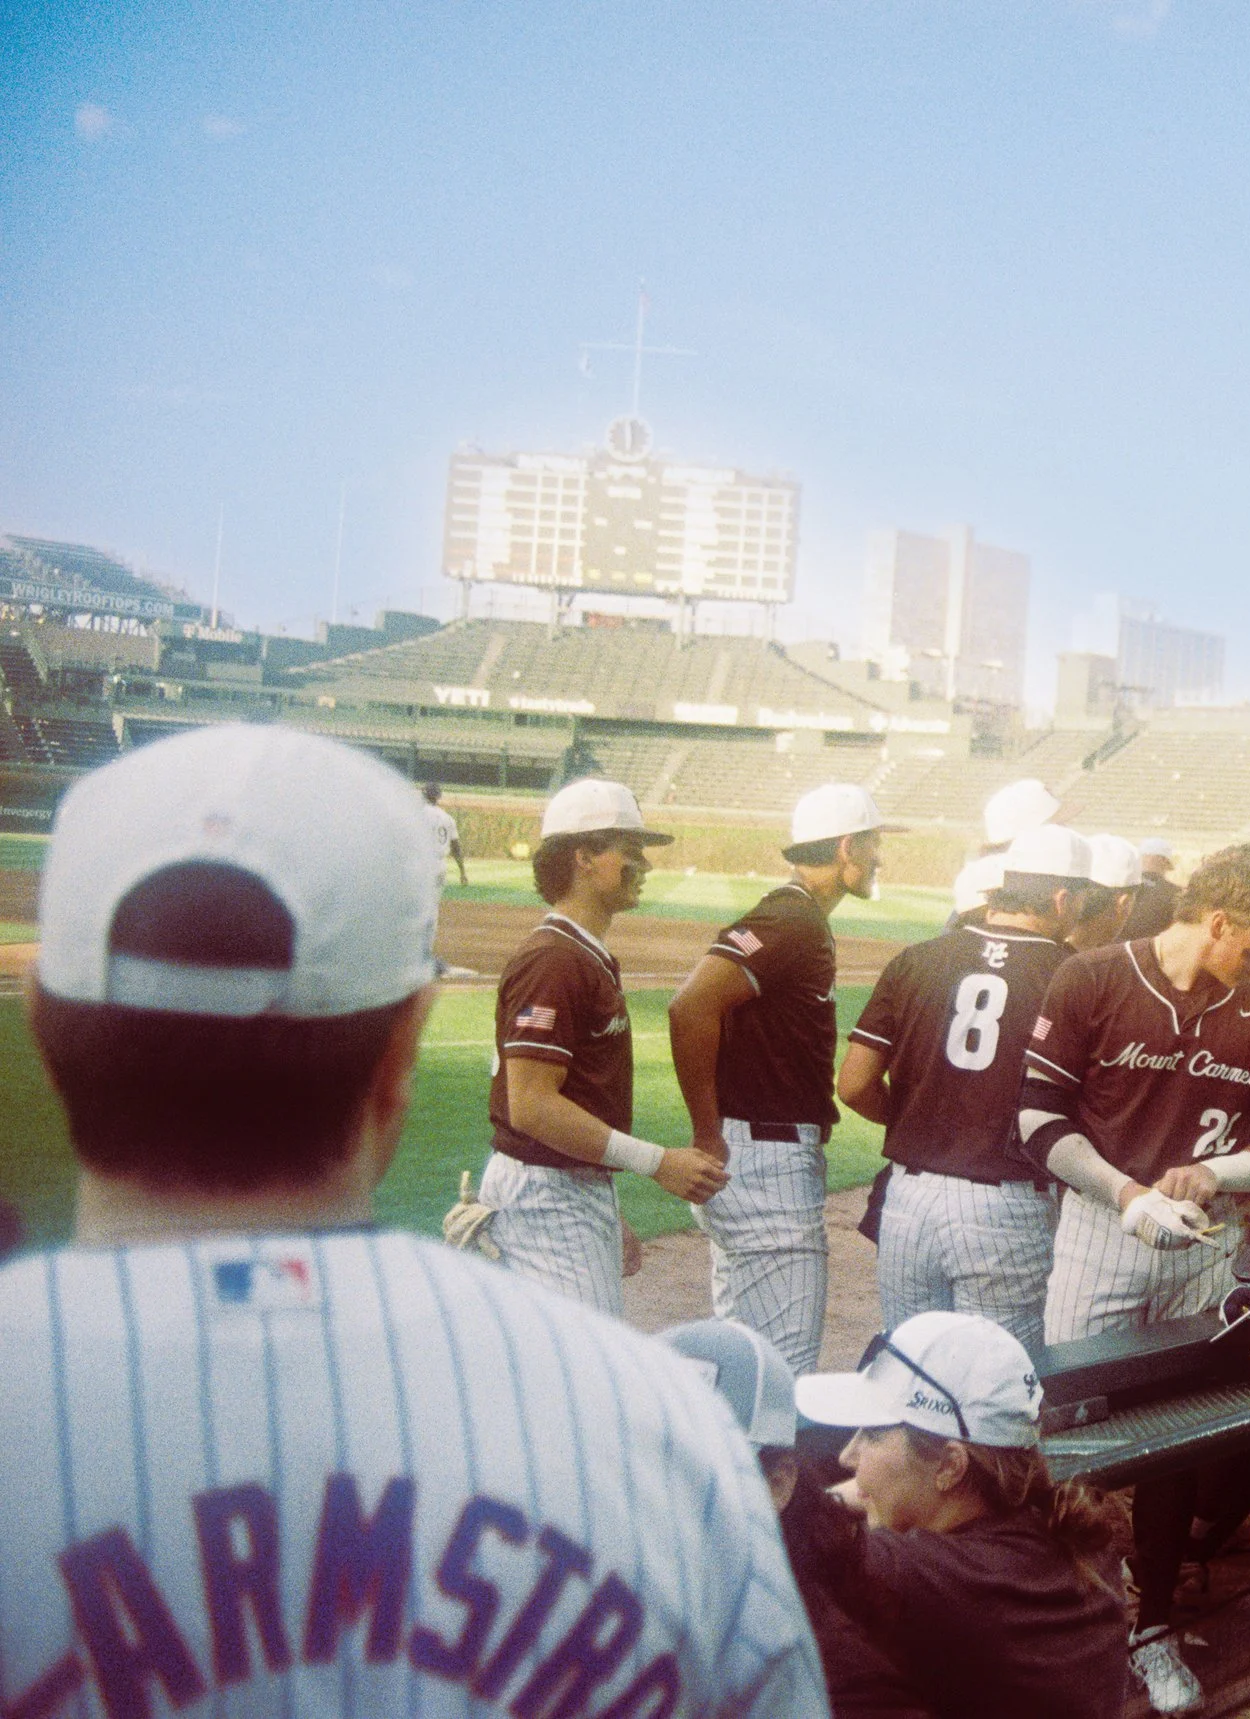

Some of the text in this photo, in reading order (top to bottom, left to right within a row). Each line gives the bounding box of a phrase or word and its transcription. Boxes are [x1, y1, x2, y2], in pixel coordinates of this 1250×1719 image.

[434, 686, 490, 708] YETI
[946, 973, 1009, 1071] 8
[1101, 1041, 1185, 1071] Mount
